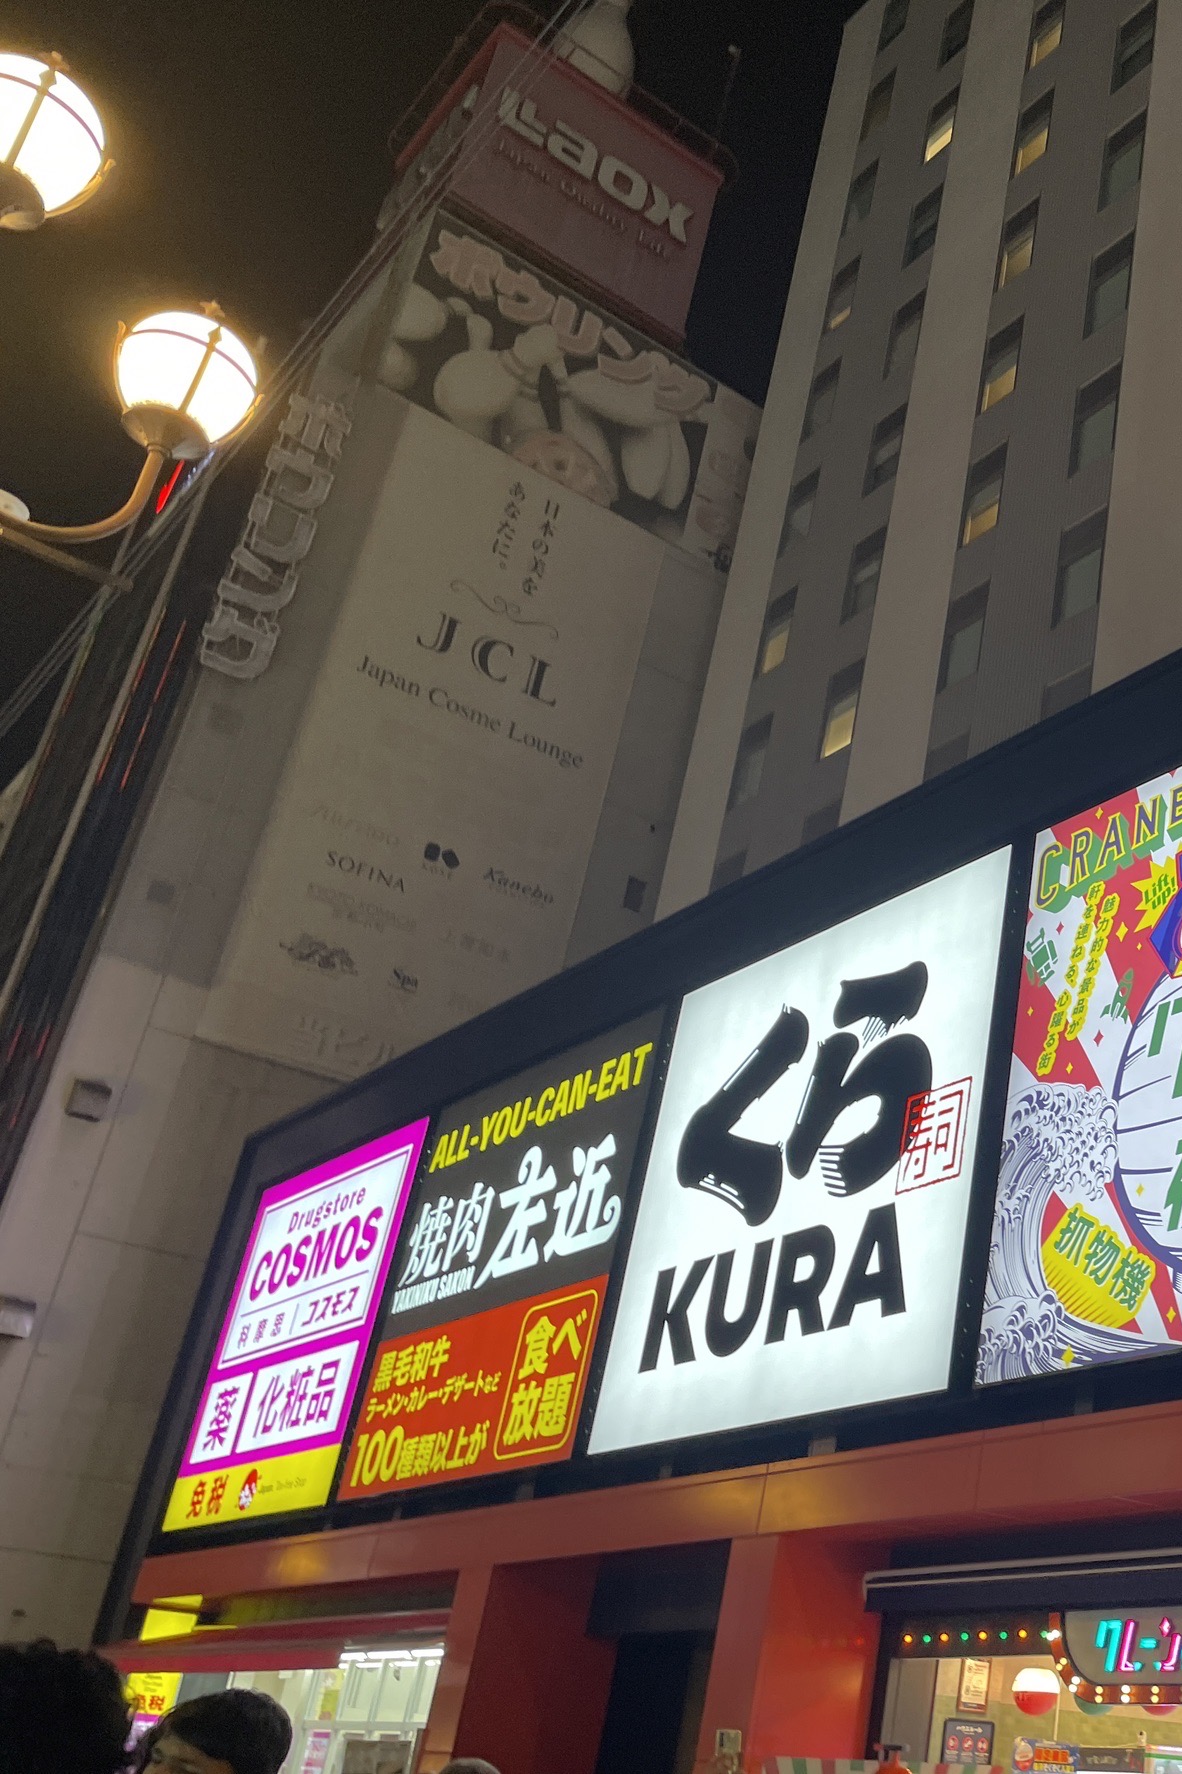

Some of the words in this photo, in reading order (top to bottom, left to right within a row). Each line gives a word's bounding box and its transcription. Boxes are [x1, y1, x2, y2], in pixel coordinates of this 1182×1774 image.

[429, 229, 712, 414] ボウリング
[356, 654, 421, 698] Japan
[428, 686, 502, 735] Cosme
[507, 721, 584, 771] Lounge
[325, 850, 406, 894] SOFINA
[482, 866, 555, 903] Kanebo
[1144, 873, 1168, 905] Lift
[1151, 876, 1176, 910] up!
[1067, 893, 1118, 1040] 魅力的な景品が
[429, 1042, 654, 1174] ALL-YOU-CAN-EAT
[677, 960, 933, 1227] くら
[287, 1187, 367, 1236] Drugstore
[249, 1206, 384, 1302] COSMOS
[638, 1202, 907, 1375] KURA
[1054, 1206, 1150, 1311] 抓物機
[300, 1285, 361, 1327] コスモス
[372, 1335, 452, 1393] 黒毛和牛
[518, 1308, 590, 1378] 食べ
[203, 1386, 240, 1451] 薬
[253, 1358, 341, 1439] 化粧品
[366, 1369, 502, 1423] ラーメン・カレー・デザートなど
[502, 1373, 577, 1447] 放題
[350, 1419, 491, 1487] 100種類以上が
[186, 1474, 229, 1519] 免税
